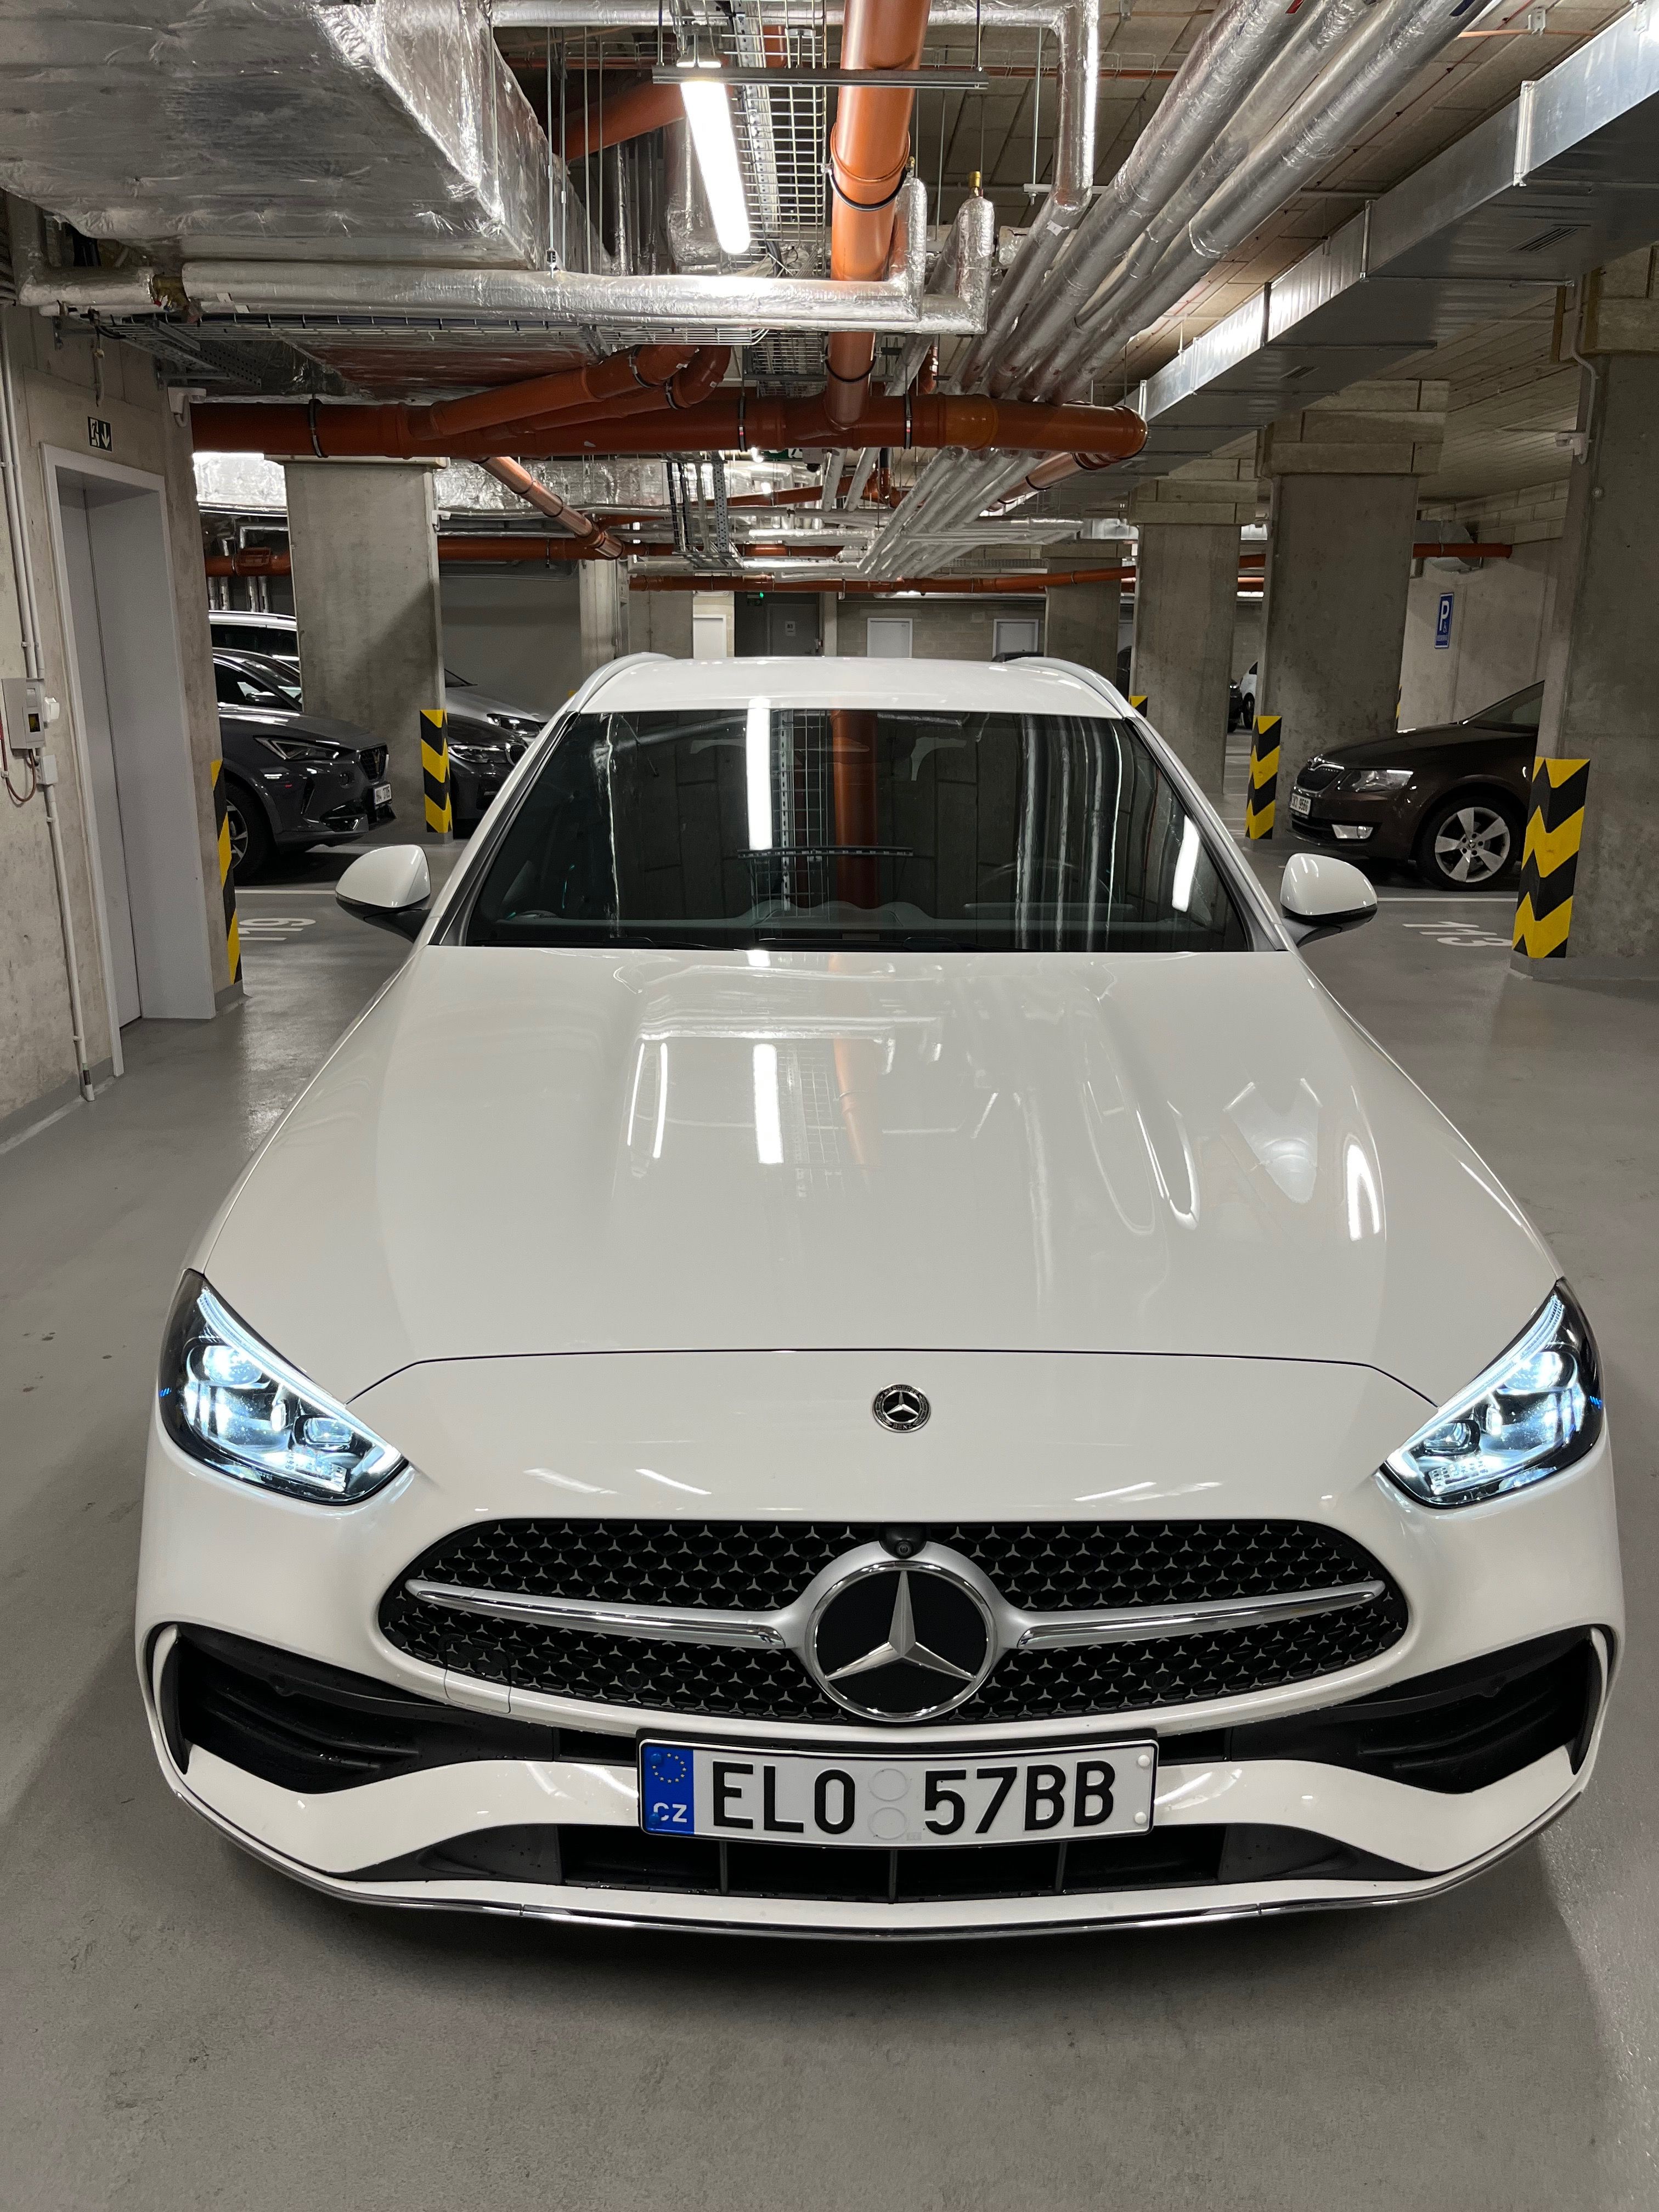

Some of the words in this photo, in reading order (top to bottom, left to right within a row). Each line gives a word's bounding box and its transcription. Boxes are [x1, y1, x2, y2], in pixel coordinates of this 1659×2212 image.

[1439, 600, 1449, 631] P
[653, 1802, 687, 1823] CZ
[924, 1759, 1116, 1835] 57BB
